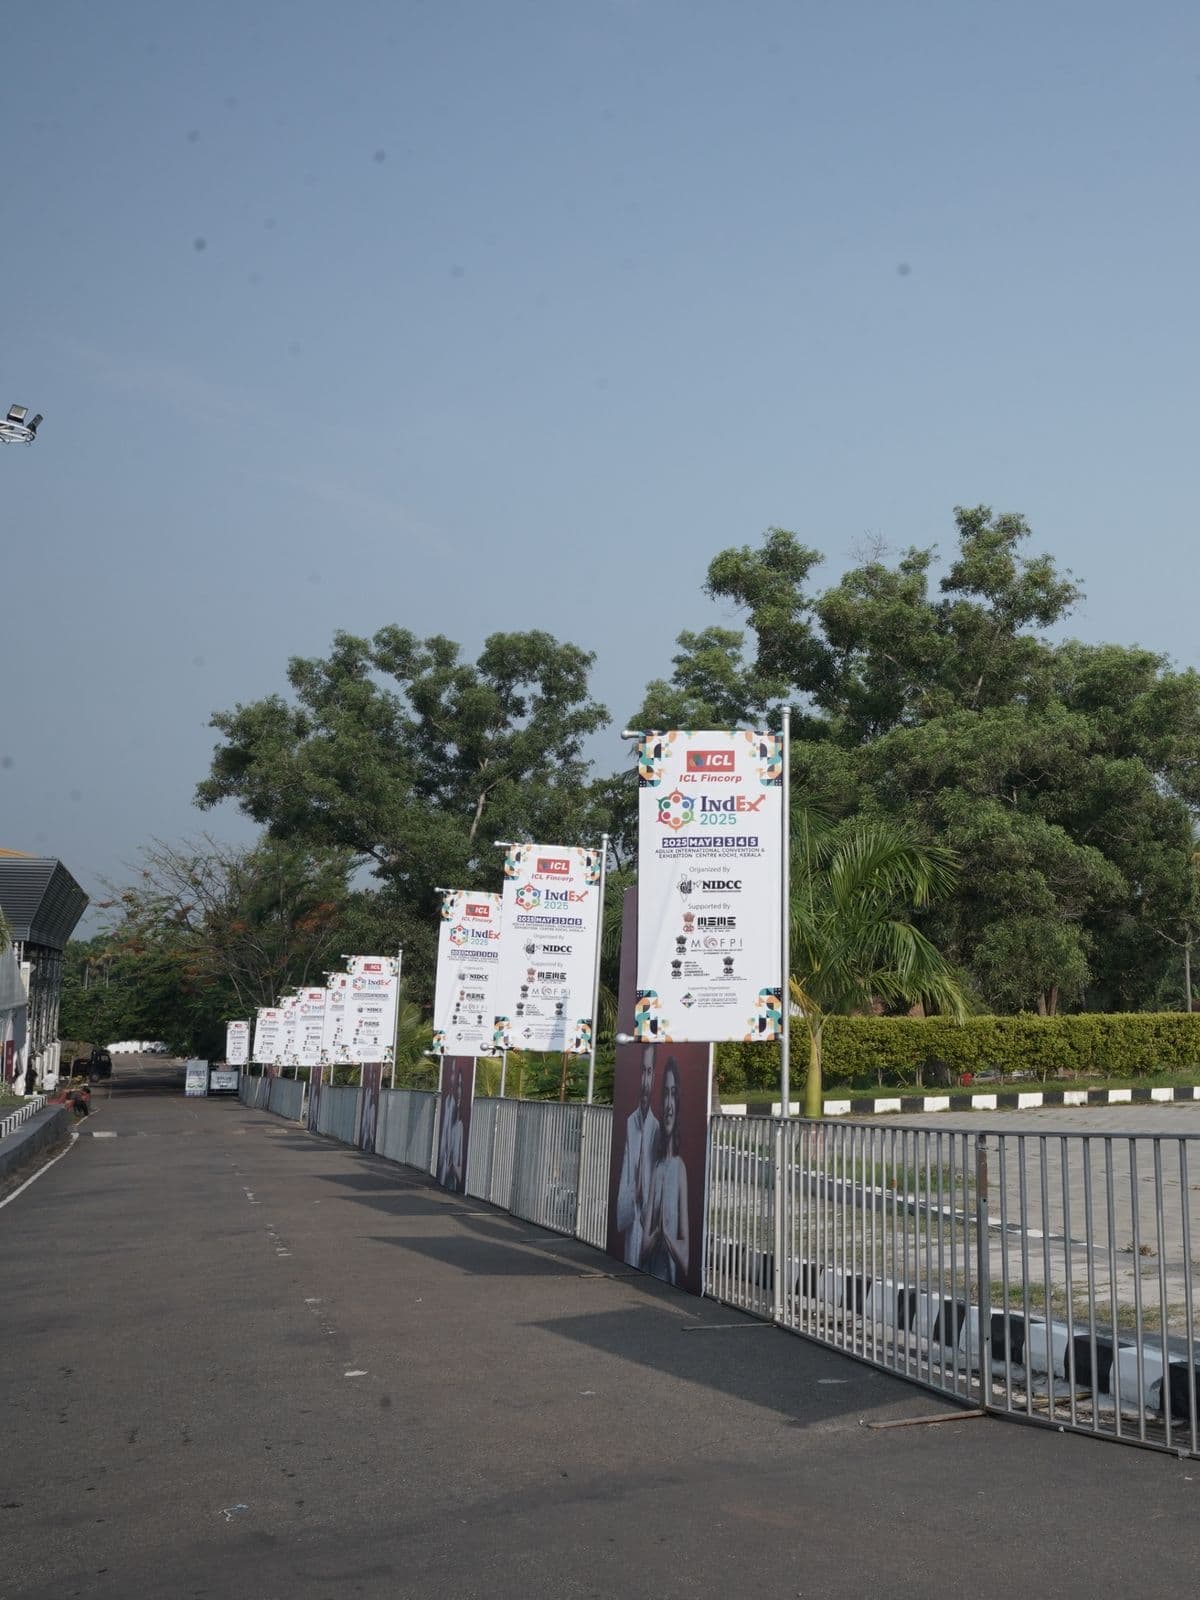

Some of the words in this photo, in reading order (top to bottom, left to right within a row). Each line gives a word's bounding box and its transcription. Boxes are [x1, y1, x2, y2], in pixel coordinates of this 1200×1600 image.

[706, 754, 733, 767] ICL
[680, 774, 697, 782] ICL
[700, 774, 742, 784] Fincorp
[700, 813, 737, 825] 2025
[663, 838, 687, 847] 2025
[689, 838, 712, 847] MAY
[550, 862, 568, 871] ICL
[702, 880, 742, 889] NIDCC
[544, 901, 568, 910] 2025
[543, 945, 572, 953] NIDCC
